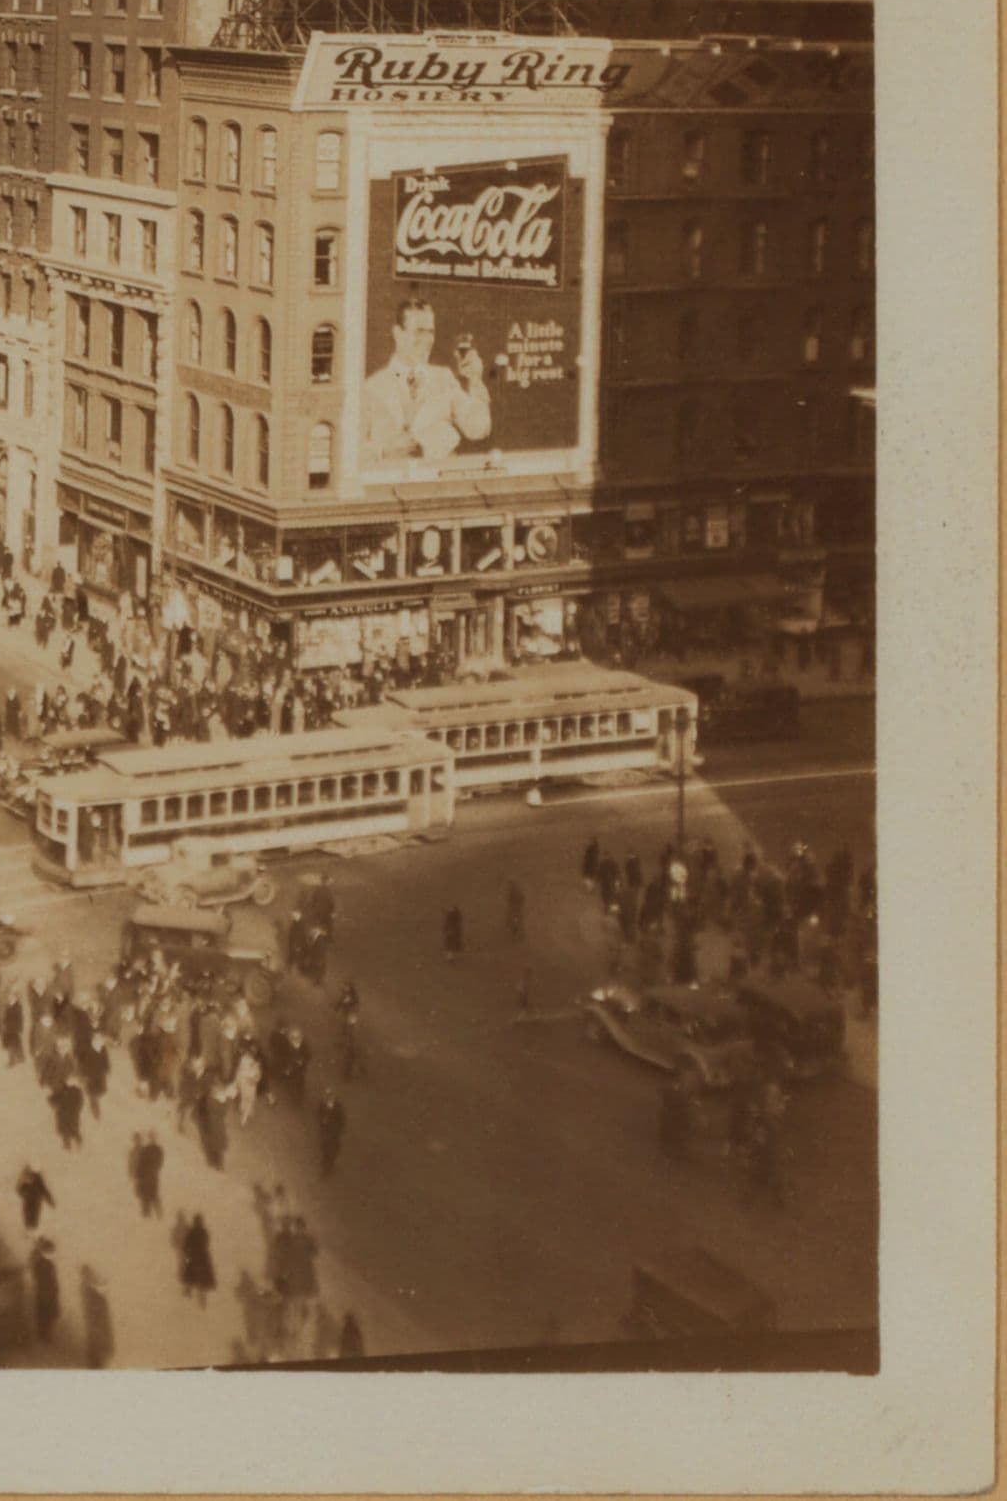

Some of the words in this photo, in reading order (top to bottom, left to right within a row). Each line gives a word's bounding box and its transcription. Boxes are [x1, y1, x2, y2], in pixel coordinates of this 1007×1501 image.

[334, 46, 487, 90] Ruby
[501, 50, 632, 92] Ring
[330, 88, 511, 102] HOSIERY
[404, 176, 450, 194] Drink
[454, 260, 479, 277] and
[481, 258, 558, 287] Refreshing
[509, 322, 523, 339] A
[526, 320, 564, 339] little
[507, 339, 564, 354] minute
[517, 353, 542, 371] for
[543, 354, 552, 366] a
